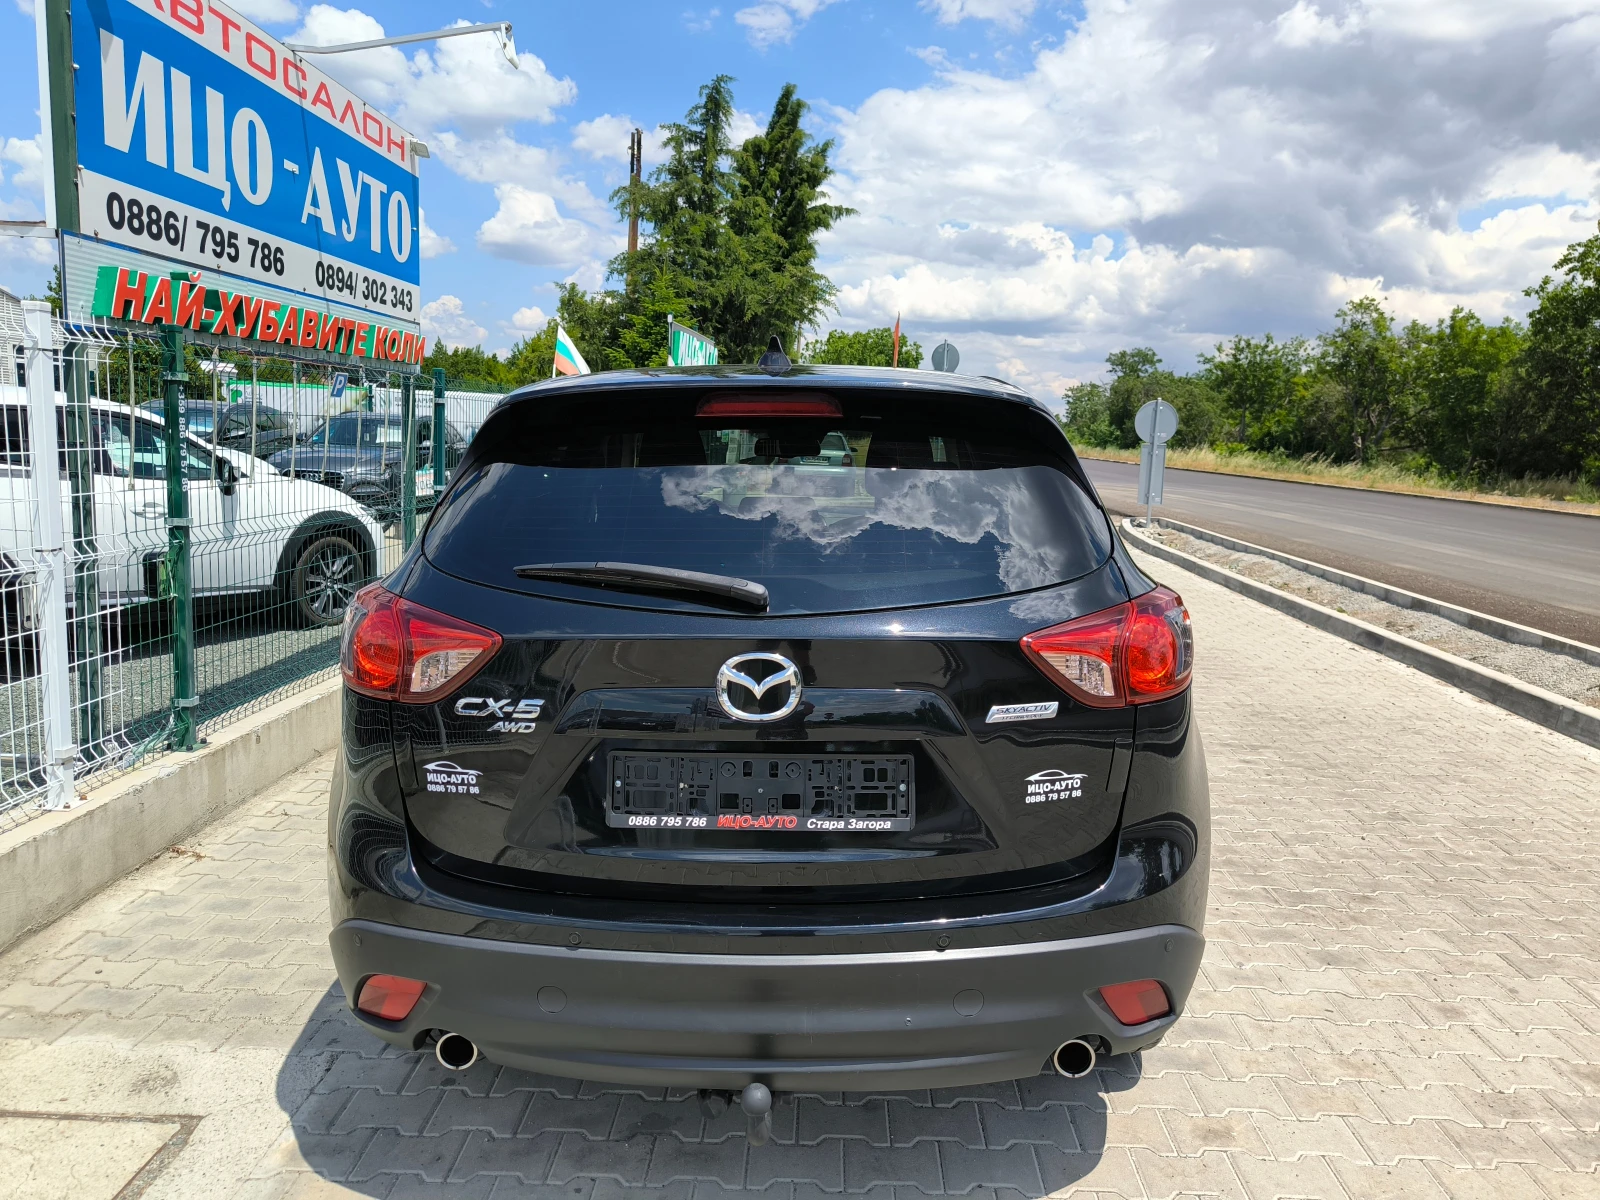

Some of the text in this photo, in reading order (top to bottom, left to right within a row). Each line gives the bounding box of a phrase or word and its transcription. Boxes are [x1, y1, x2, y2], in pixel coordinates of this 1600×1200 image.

[106, 191, 413, 312] 0886/ 795 786 0894/ 302 343
[111, 266, 427, 366] НАЙ-ХУБАВИТЕ КОЛИ
[178, 384, 186, 413] +359
[180, 442, 187, 456] 79
[181, 460, 188, 473] 57
[182, 478, 189, 492] 86
[454, 696, 545, 719] CX-5
[997, 704, 1052, 713] SKYACTIV
[487, 721, 536, 733] AWD
[426, 772, 477, 784] ИЦО-АУТО
[458, 785, 468, 794] 57
[1027, 778, 1081, 794] ИЦО-АУТО
[1025, 789, 1082, 804] 0886 79 57 86
[628, 814, 892, 830] 0886 795 786 ИЦО-АУТО Стара Загора
